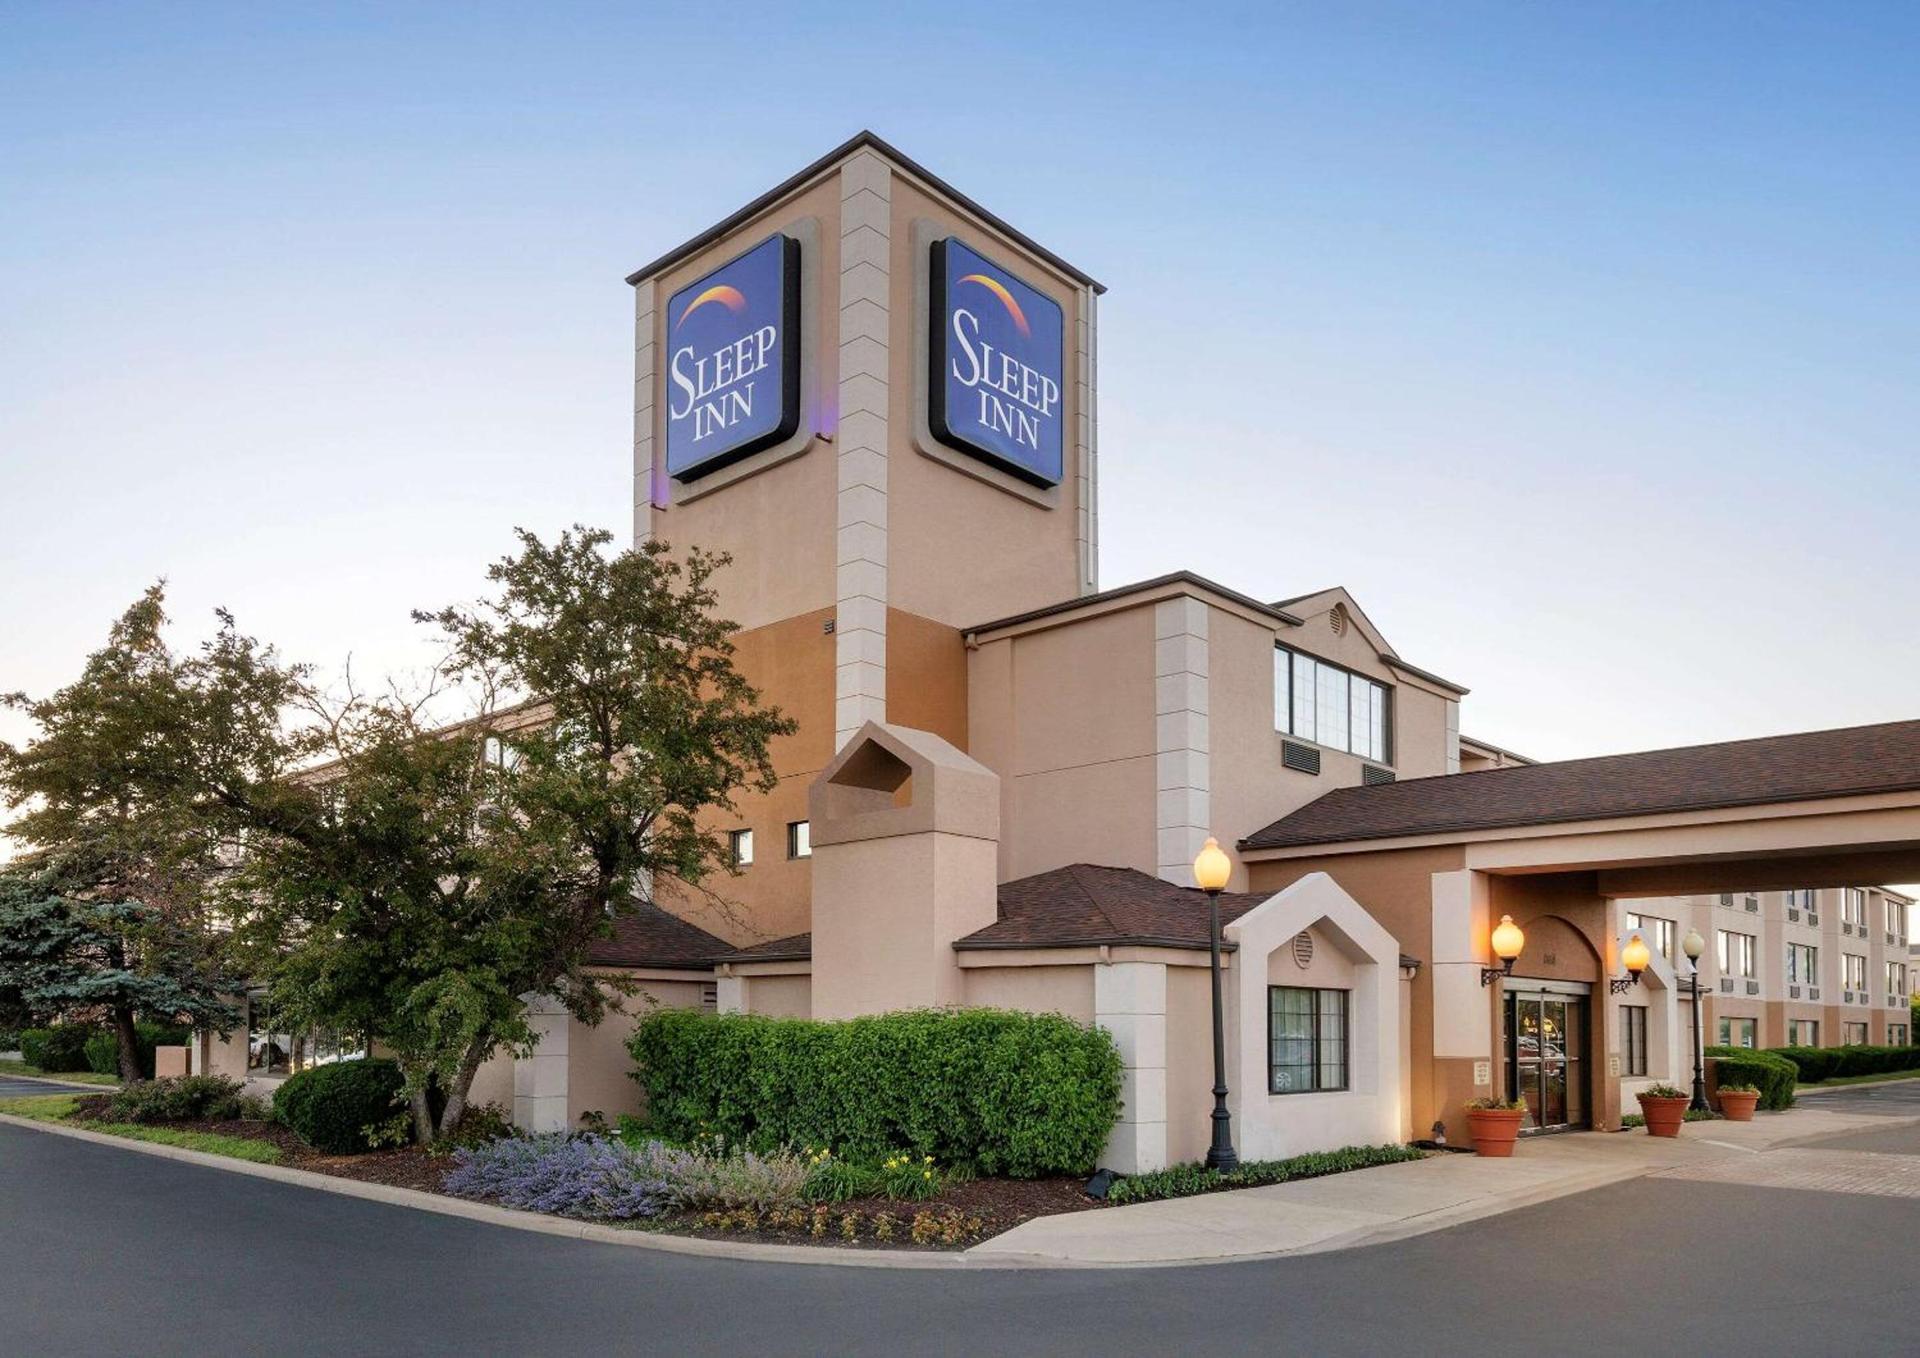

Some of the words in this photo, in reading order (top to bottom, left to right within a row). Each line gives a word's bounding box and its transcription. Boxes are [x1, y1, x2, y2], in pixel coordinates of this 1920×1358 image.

[671, 326, 776, 420] SLEEP
[952, 309, 1058, 416] SLEEP
[692, 382, 754, 441] INN
[978, 389, 1040, 450] INN
